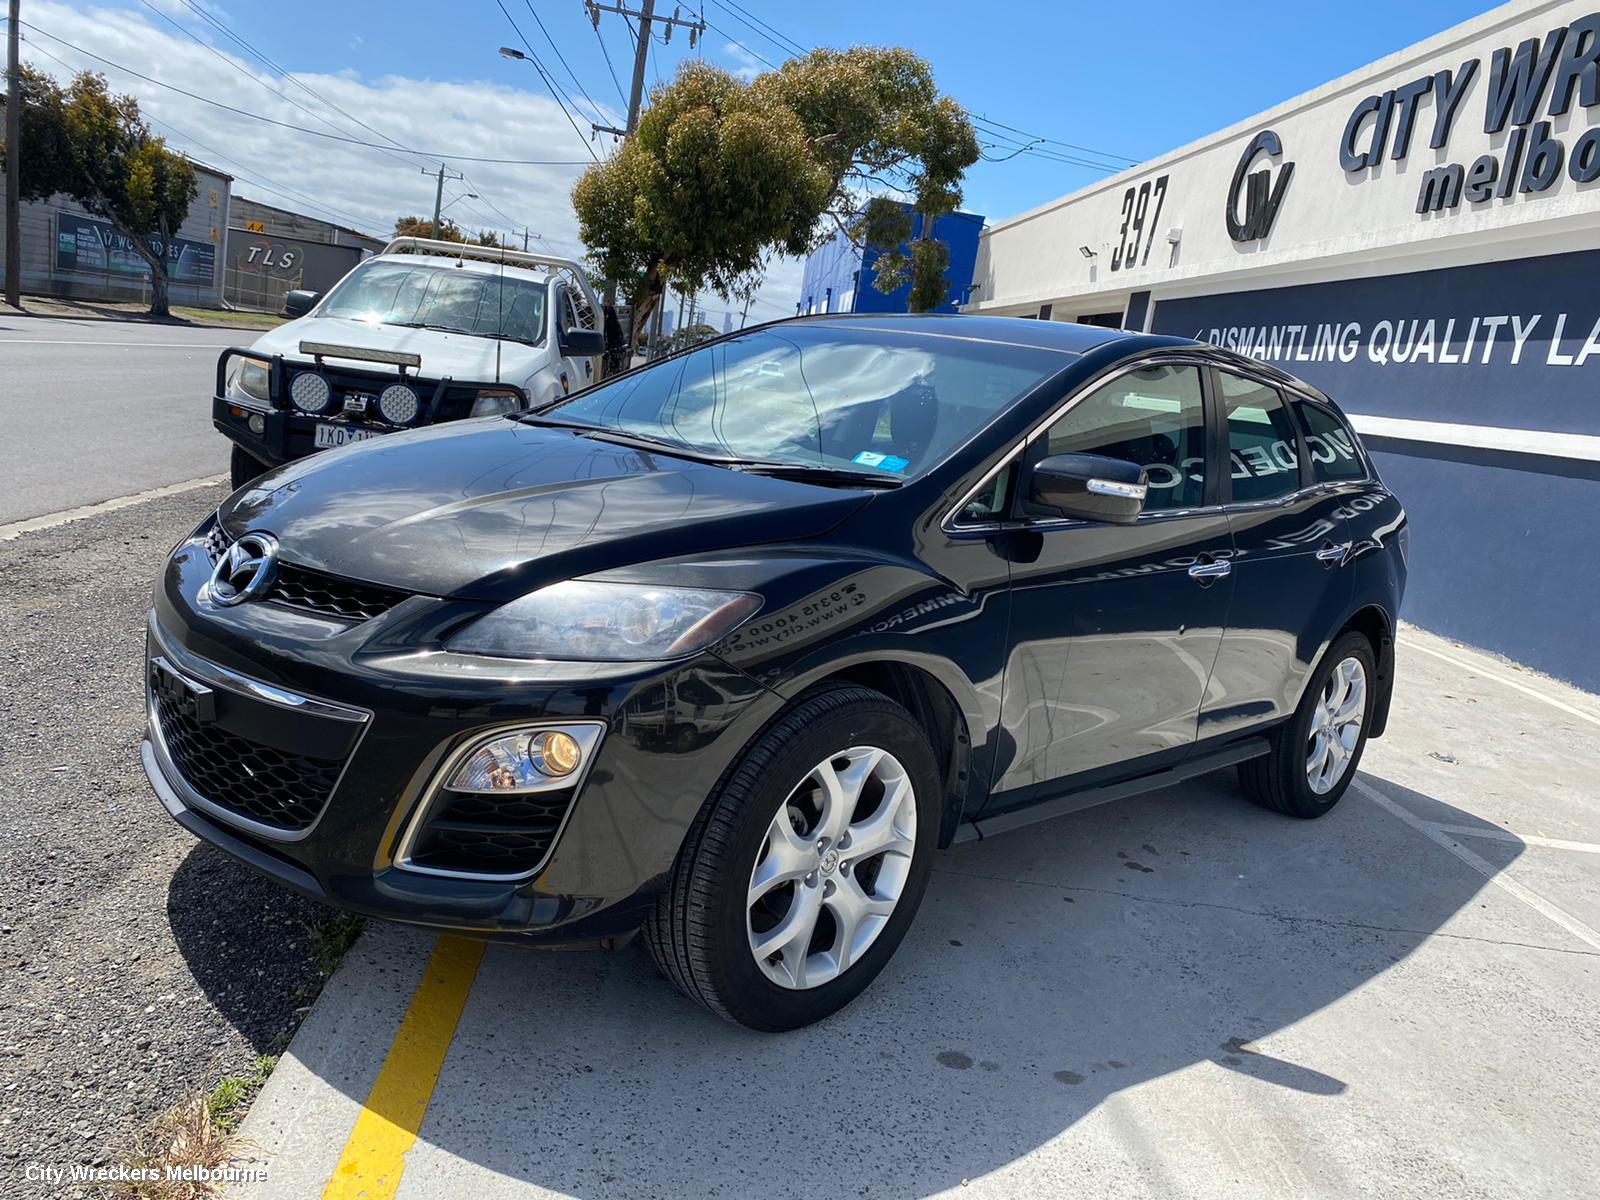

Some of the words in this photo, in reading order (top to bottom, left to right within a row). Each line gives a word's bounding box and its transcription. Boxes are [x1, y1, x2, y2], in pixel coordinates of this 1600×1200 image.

[1339, 58, 1480, 174] CITY
[248, 246, 295, 268] TLS
[1110, 174, 1169, 272] 397
[1209, 320, 1362, 363] DISMANTLING
[1368, 314, 1542, 366] QUALITY
